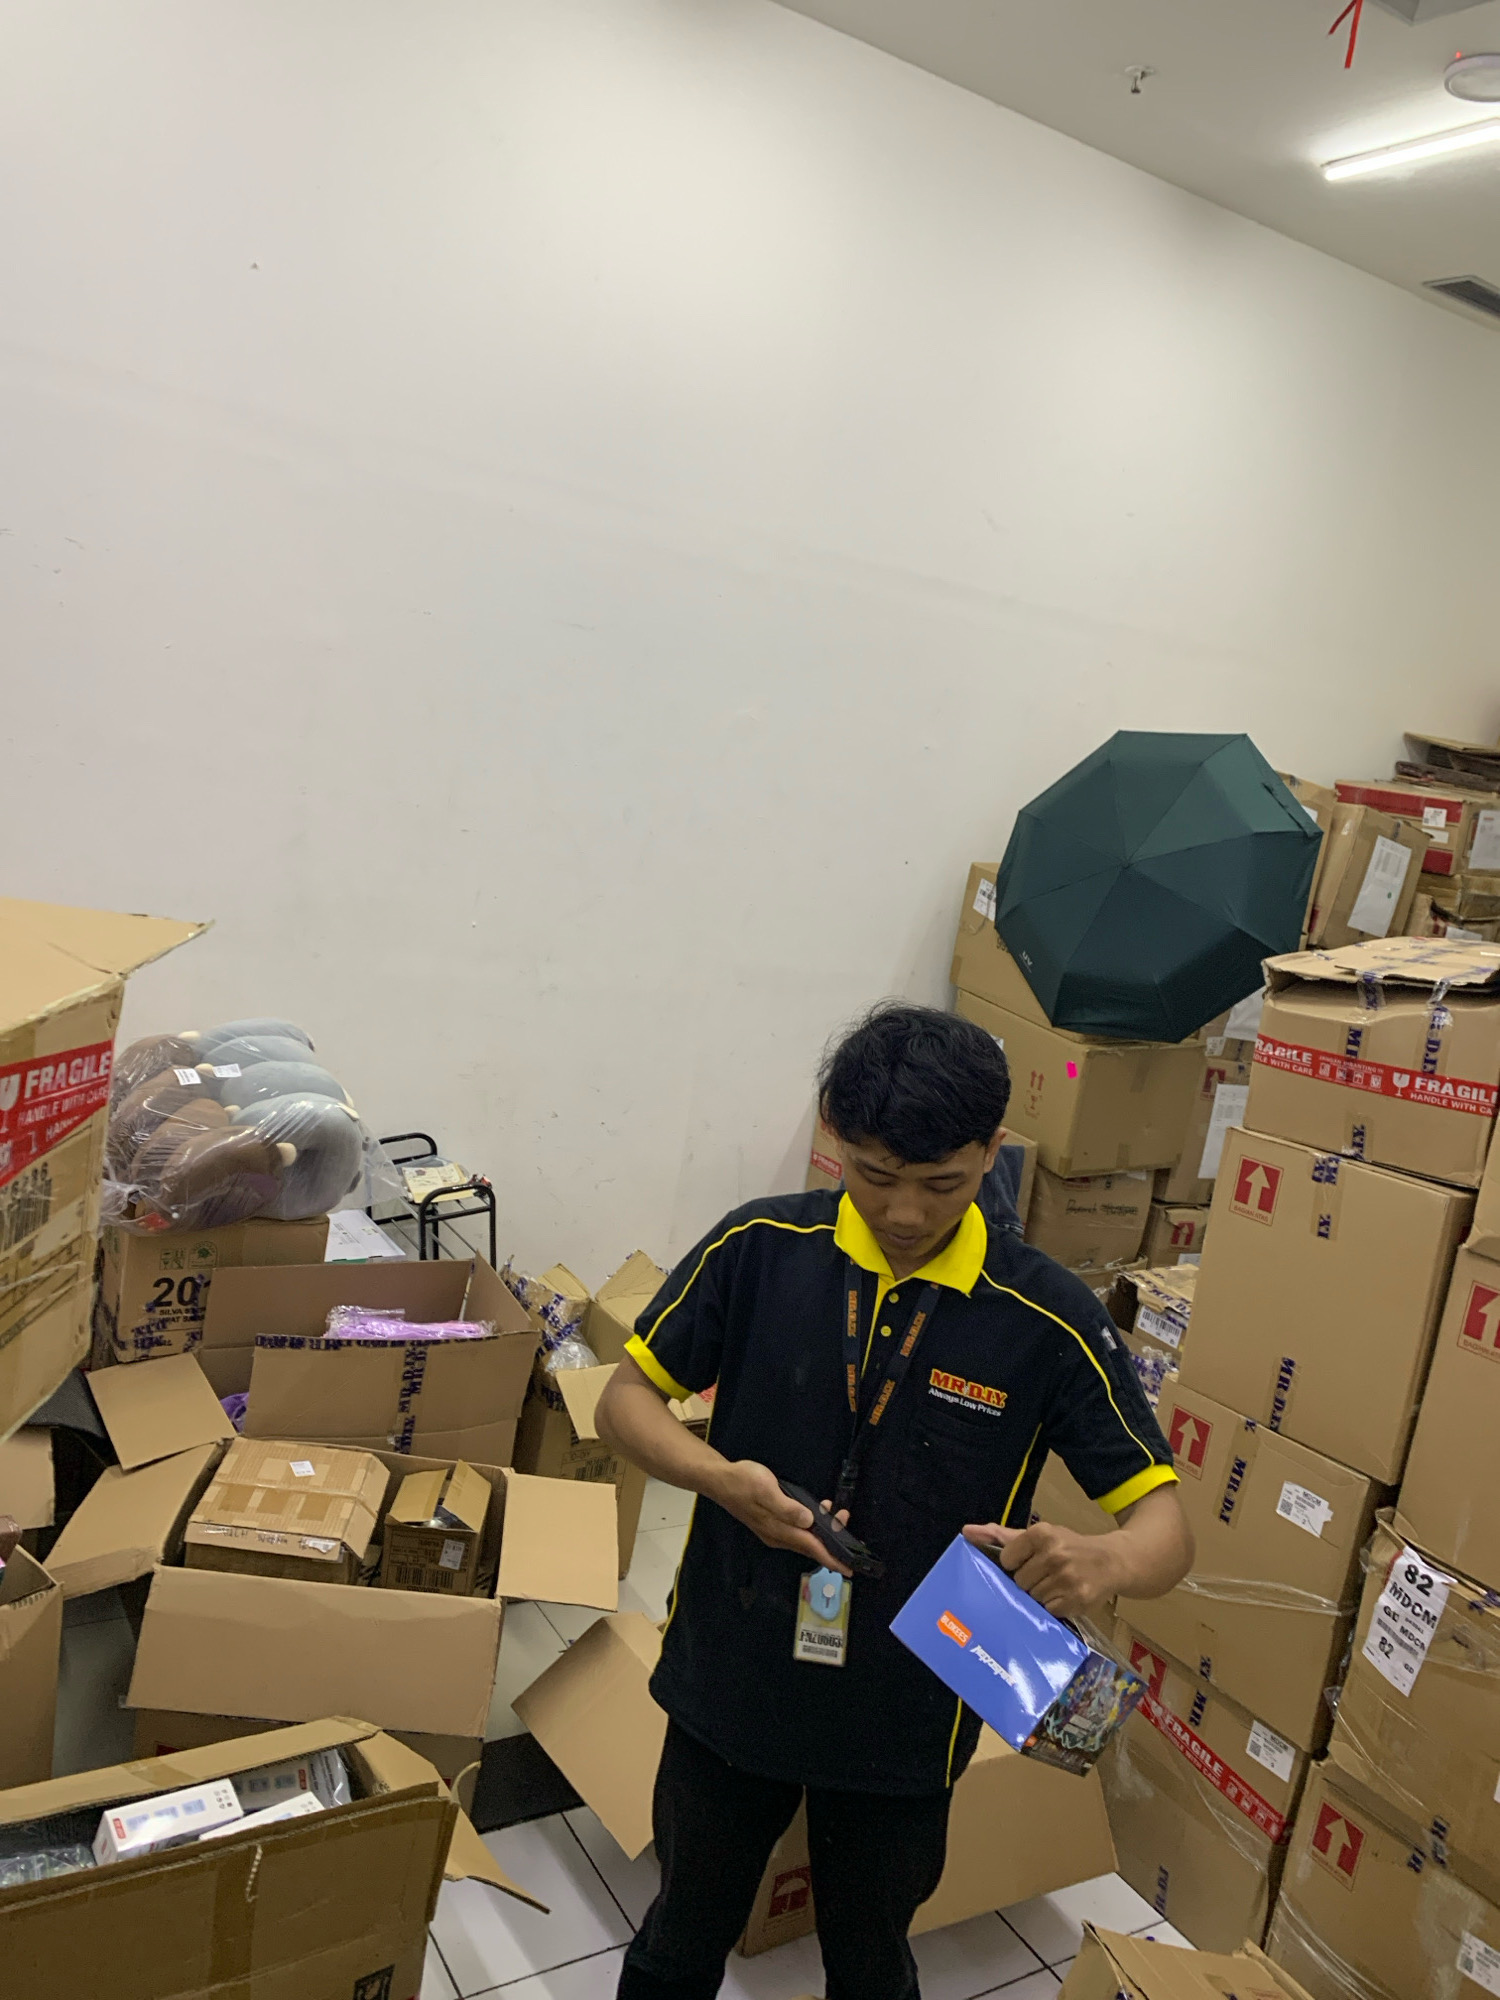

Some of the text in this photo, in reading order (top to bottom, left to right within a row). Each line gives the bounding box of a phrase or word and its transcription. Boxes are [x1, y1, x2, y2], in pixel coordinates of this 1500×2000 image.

[1255, 1039, 1313, 1064] RAGILE
[1270, 1058, 1291, 1070] WITH
[1292, 1064, 1313, 1076] CARE
[24, 1051, 112, 1099] FRAGILE
[1410, 1092, 1493, 1116] HANDLE WITH CA
[152, 1276, 212, 1308] 20
[928, 1387, 1002, 1417] Always Low Prices
[1404, 1563, 1434, 1598] 82
[1388, 1581, 1438, 1630] MDCM
[940, 1614, 969, 1643] BLOKEES
[1165, 1713, 1224, 1775] FRAGILE
